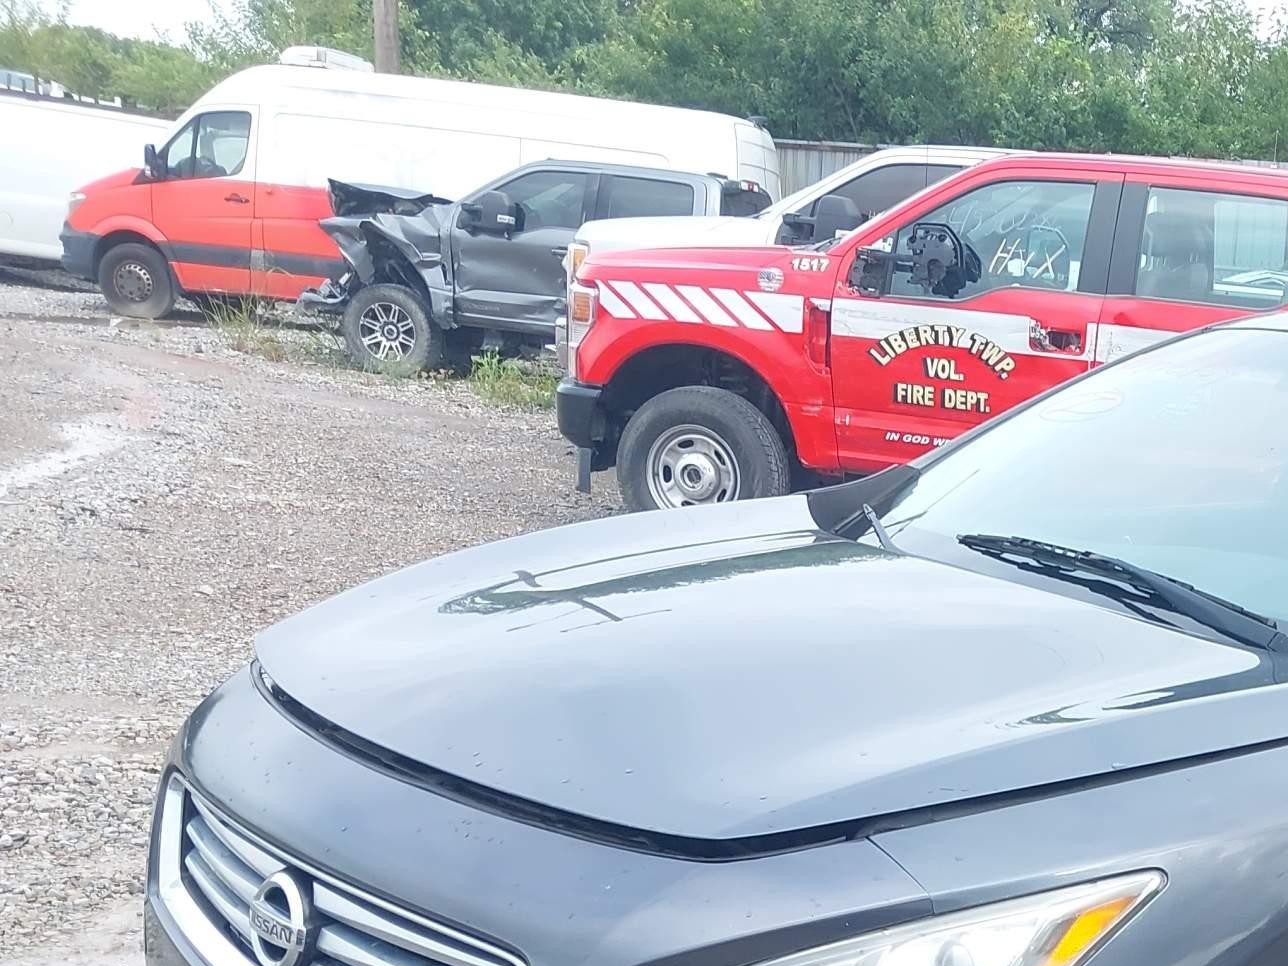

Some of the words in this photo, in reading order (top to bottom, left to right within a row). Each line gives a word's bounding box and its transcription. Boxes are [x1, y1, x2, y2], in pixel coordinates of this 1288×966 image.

[791, 257, 830, 273] 1517
[868, 324, 966, 367] LIBERTY
[924, 356, 965, 381] VOL.
[895, 382, 935, 407] FIRE
[942, 388, 991, 413] DEPT.
[885, 431, 900, 441] IN
[902, 433, 930, 445] GOD
[251, 908, 294, 945] ISSAN
